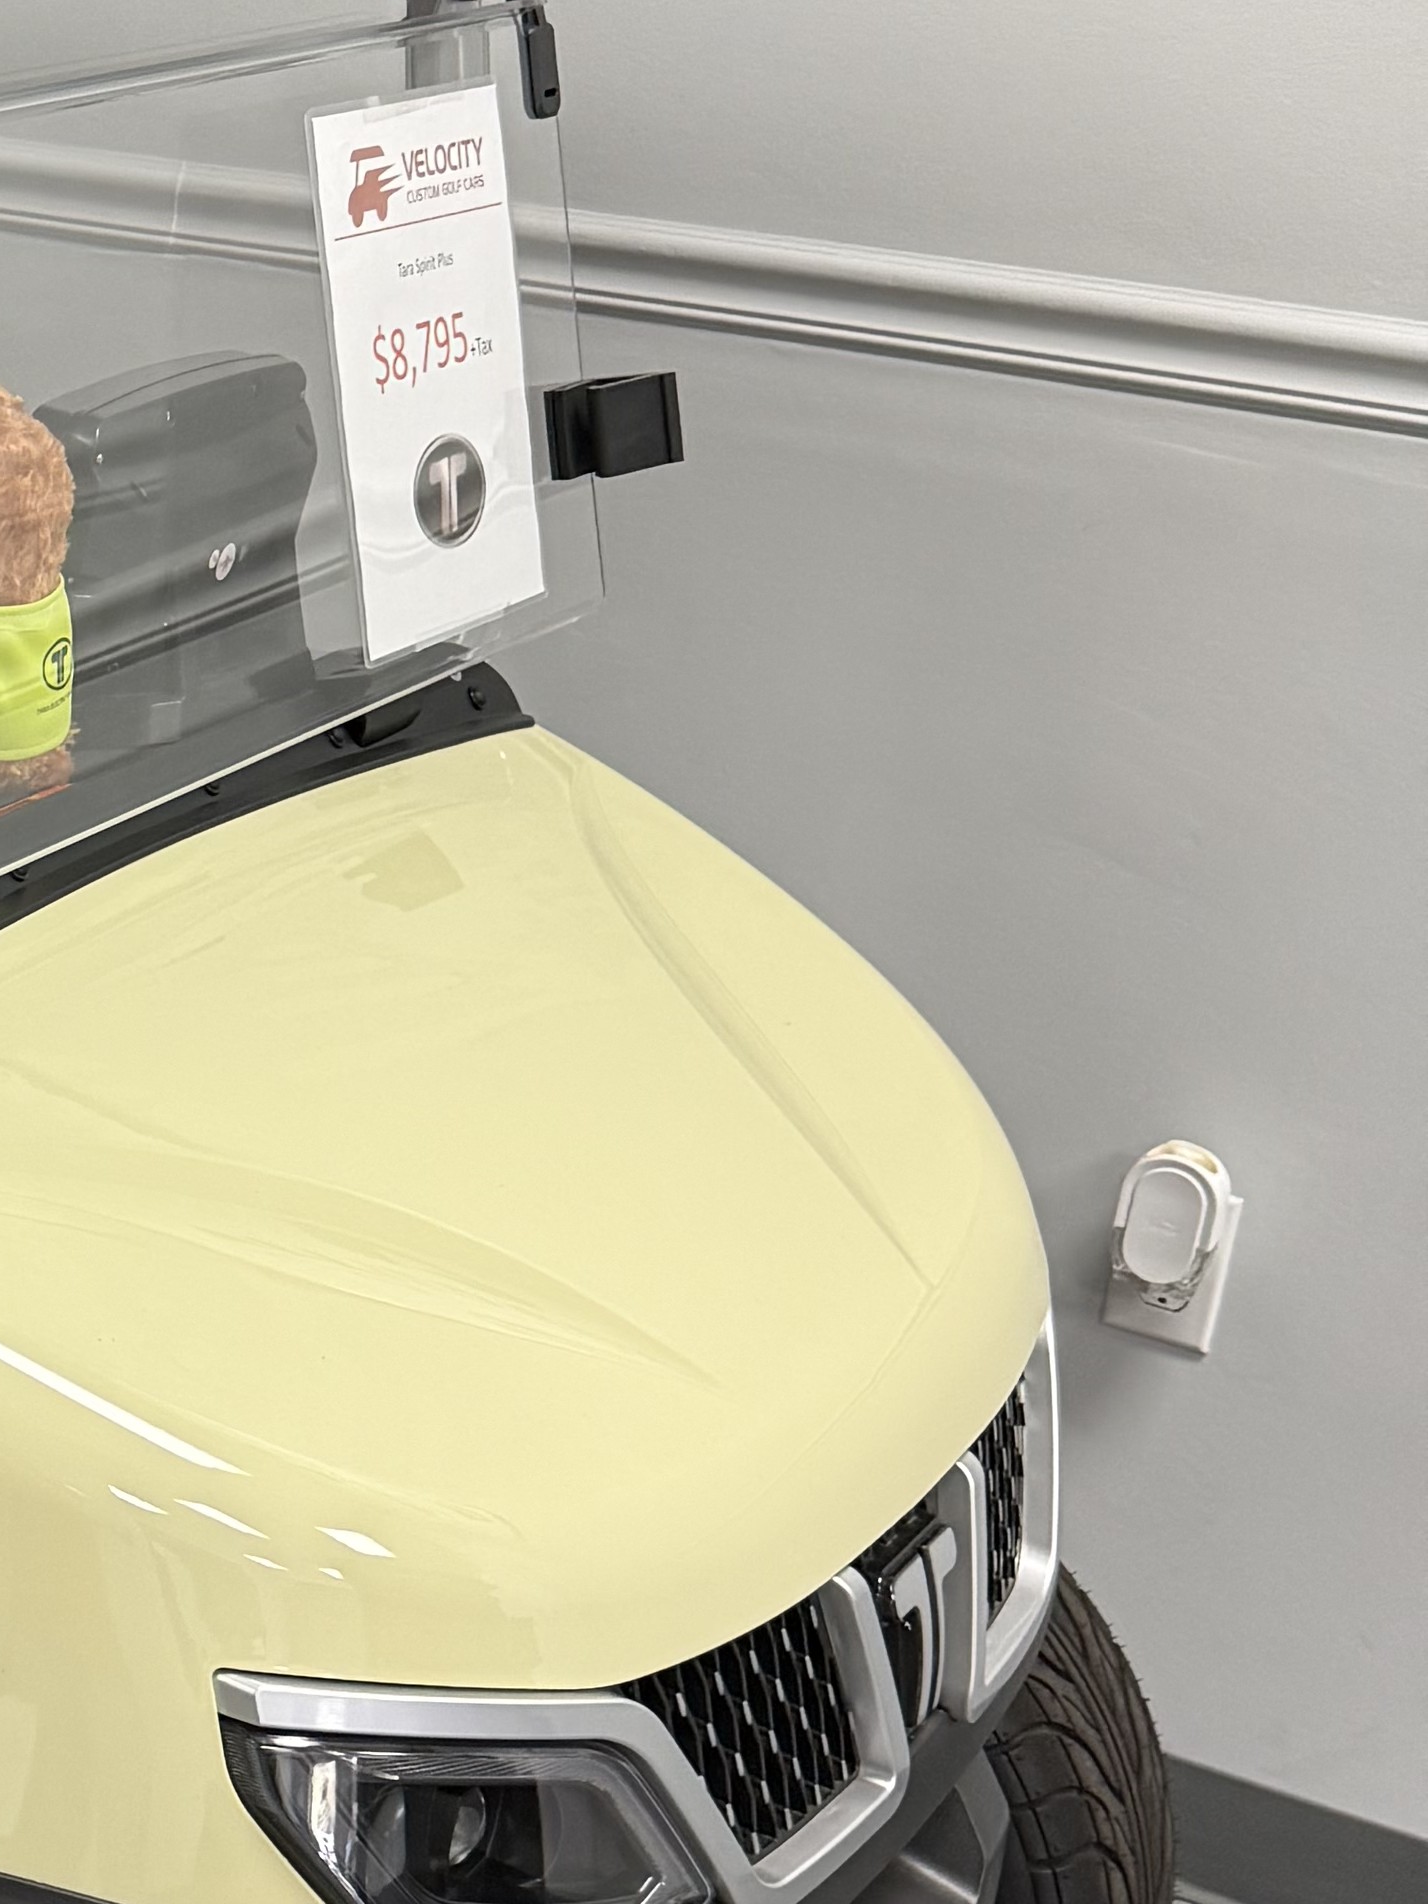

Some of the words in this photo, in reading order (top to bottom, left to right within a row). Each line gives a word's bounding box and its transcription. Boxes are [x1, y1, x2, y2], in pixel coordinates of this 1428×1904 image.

[401, 137, 483, 181] VELOCITY
[406, 186, 441, 204] CUSTOM
[442, 180, 462, 196] GOLF
[398, 262, 414, 278] Tara
[415, 256, 435, 277] Spirit
[437, 252, 454, 268] Plus
[373, 311, 468, 395] $8,795
